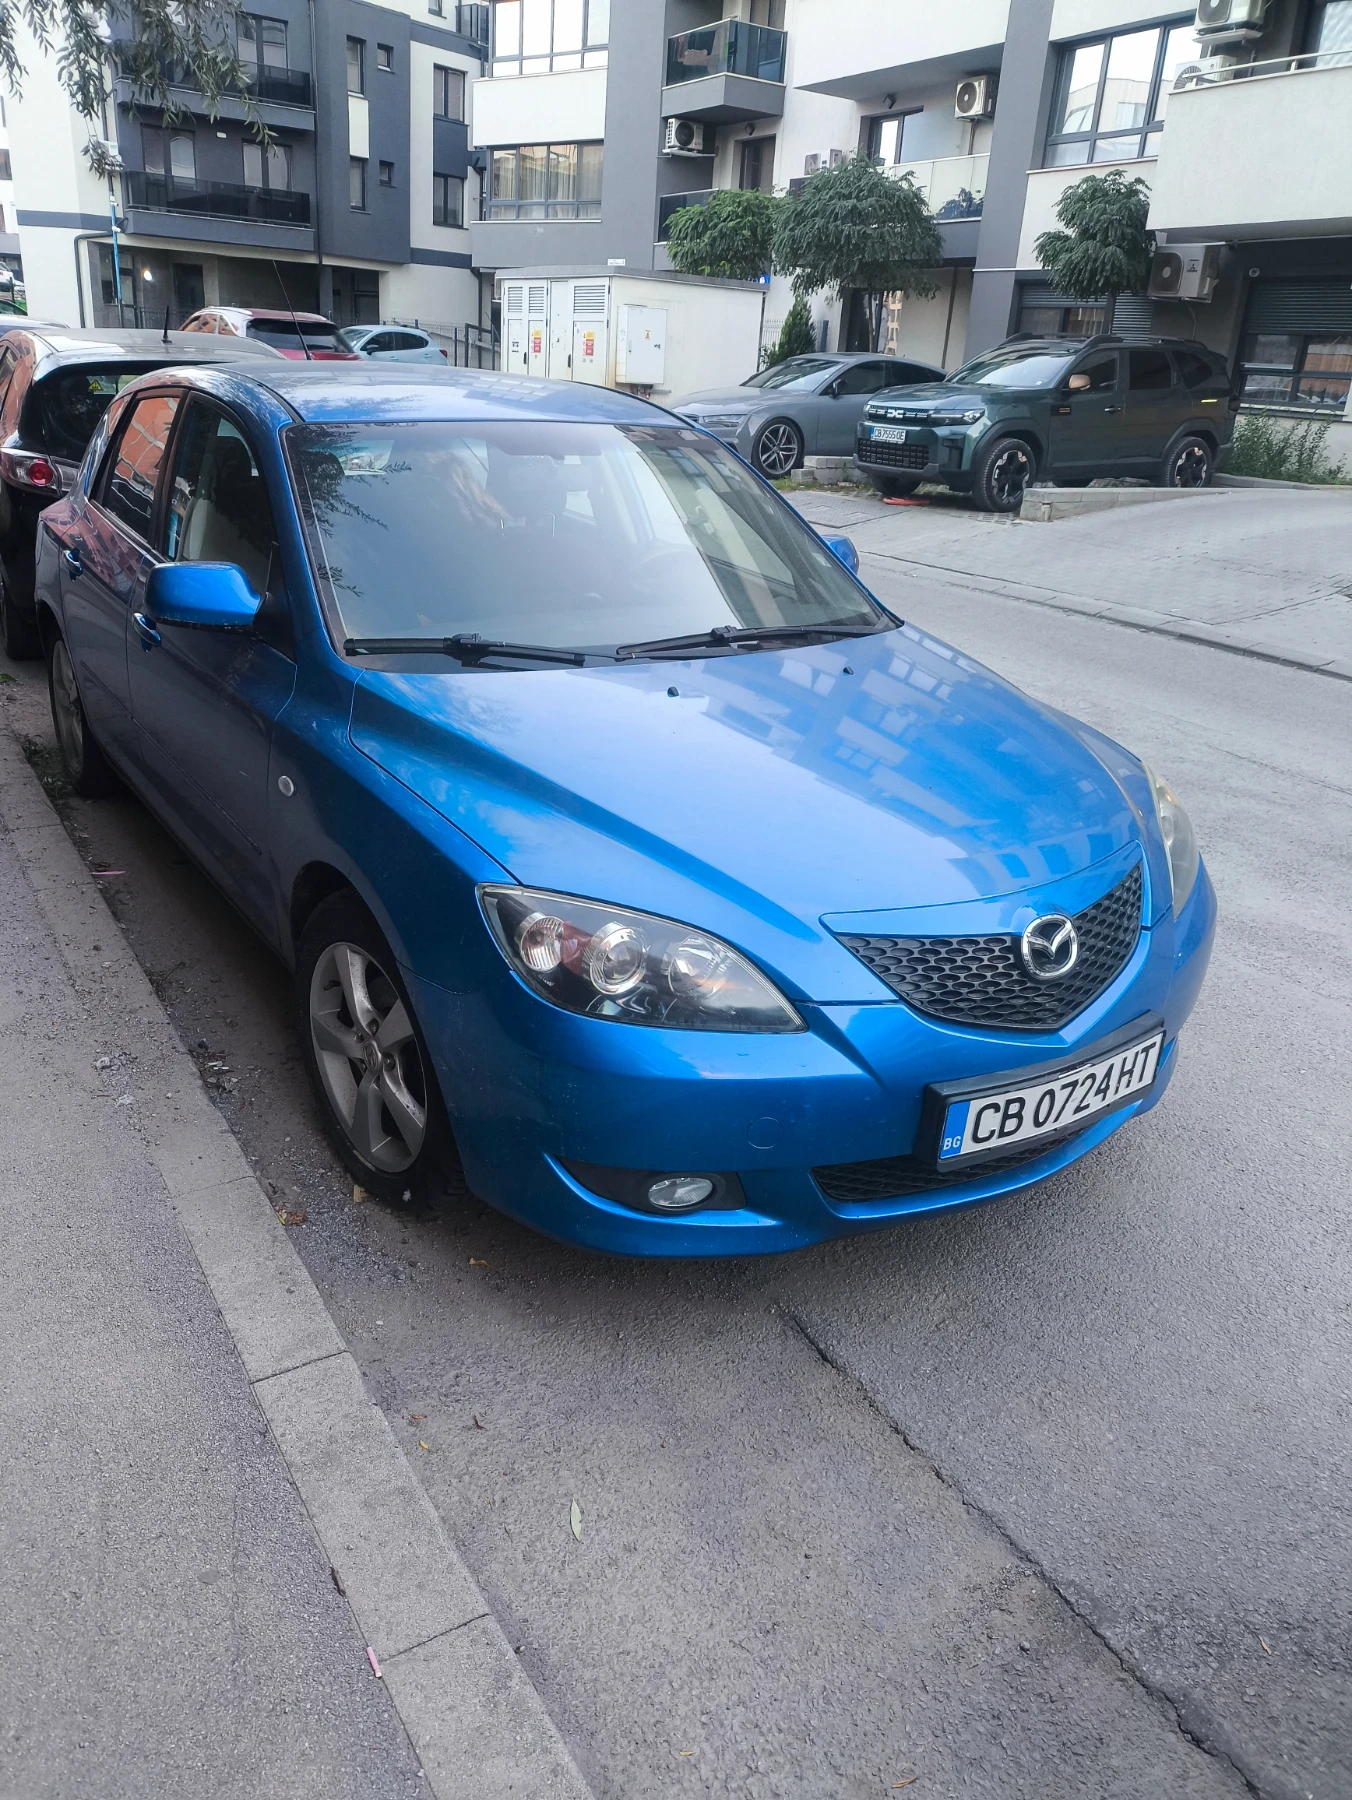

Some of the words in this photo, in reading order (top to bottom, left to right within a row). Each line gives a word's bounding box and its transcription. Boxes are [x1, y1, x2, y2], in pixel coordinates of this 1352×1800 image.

[970, 1096, 1026, 1144] CB
[1032, 1062, 1115, 1129] 0724
[1113, 1041, 1157, 1095] HT
[943, 1135, 962, 1151] BG
